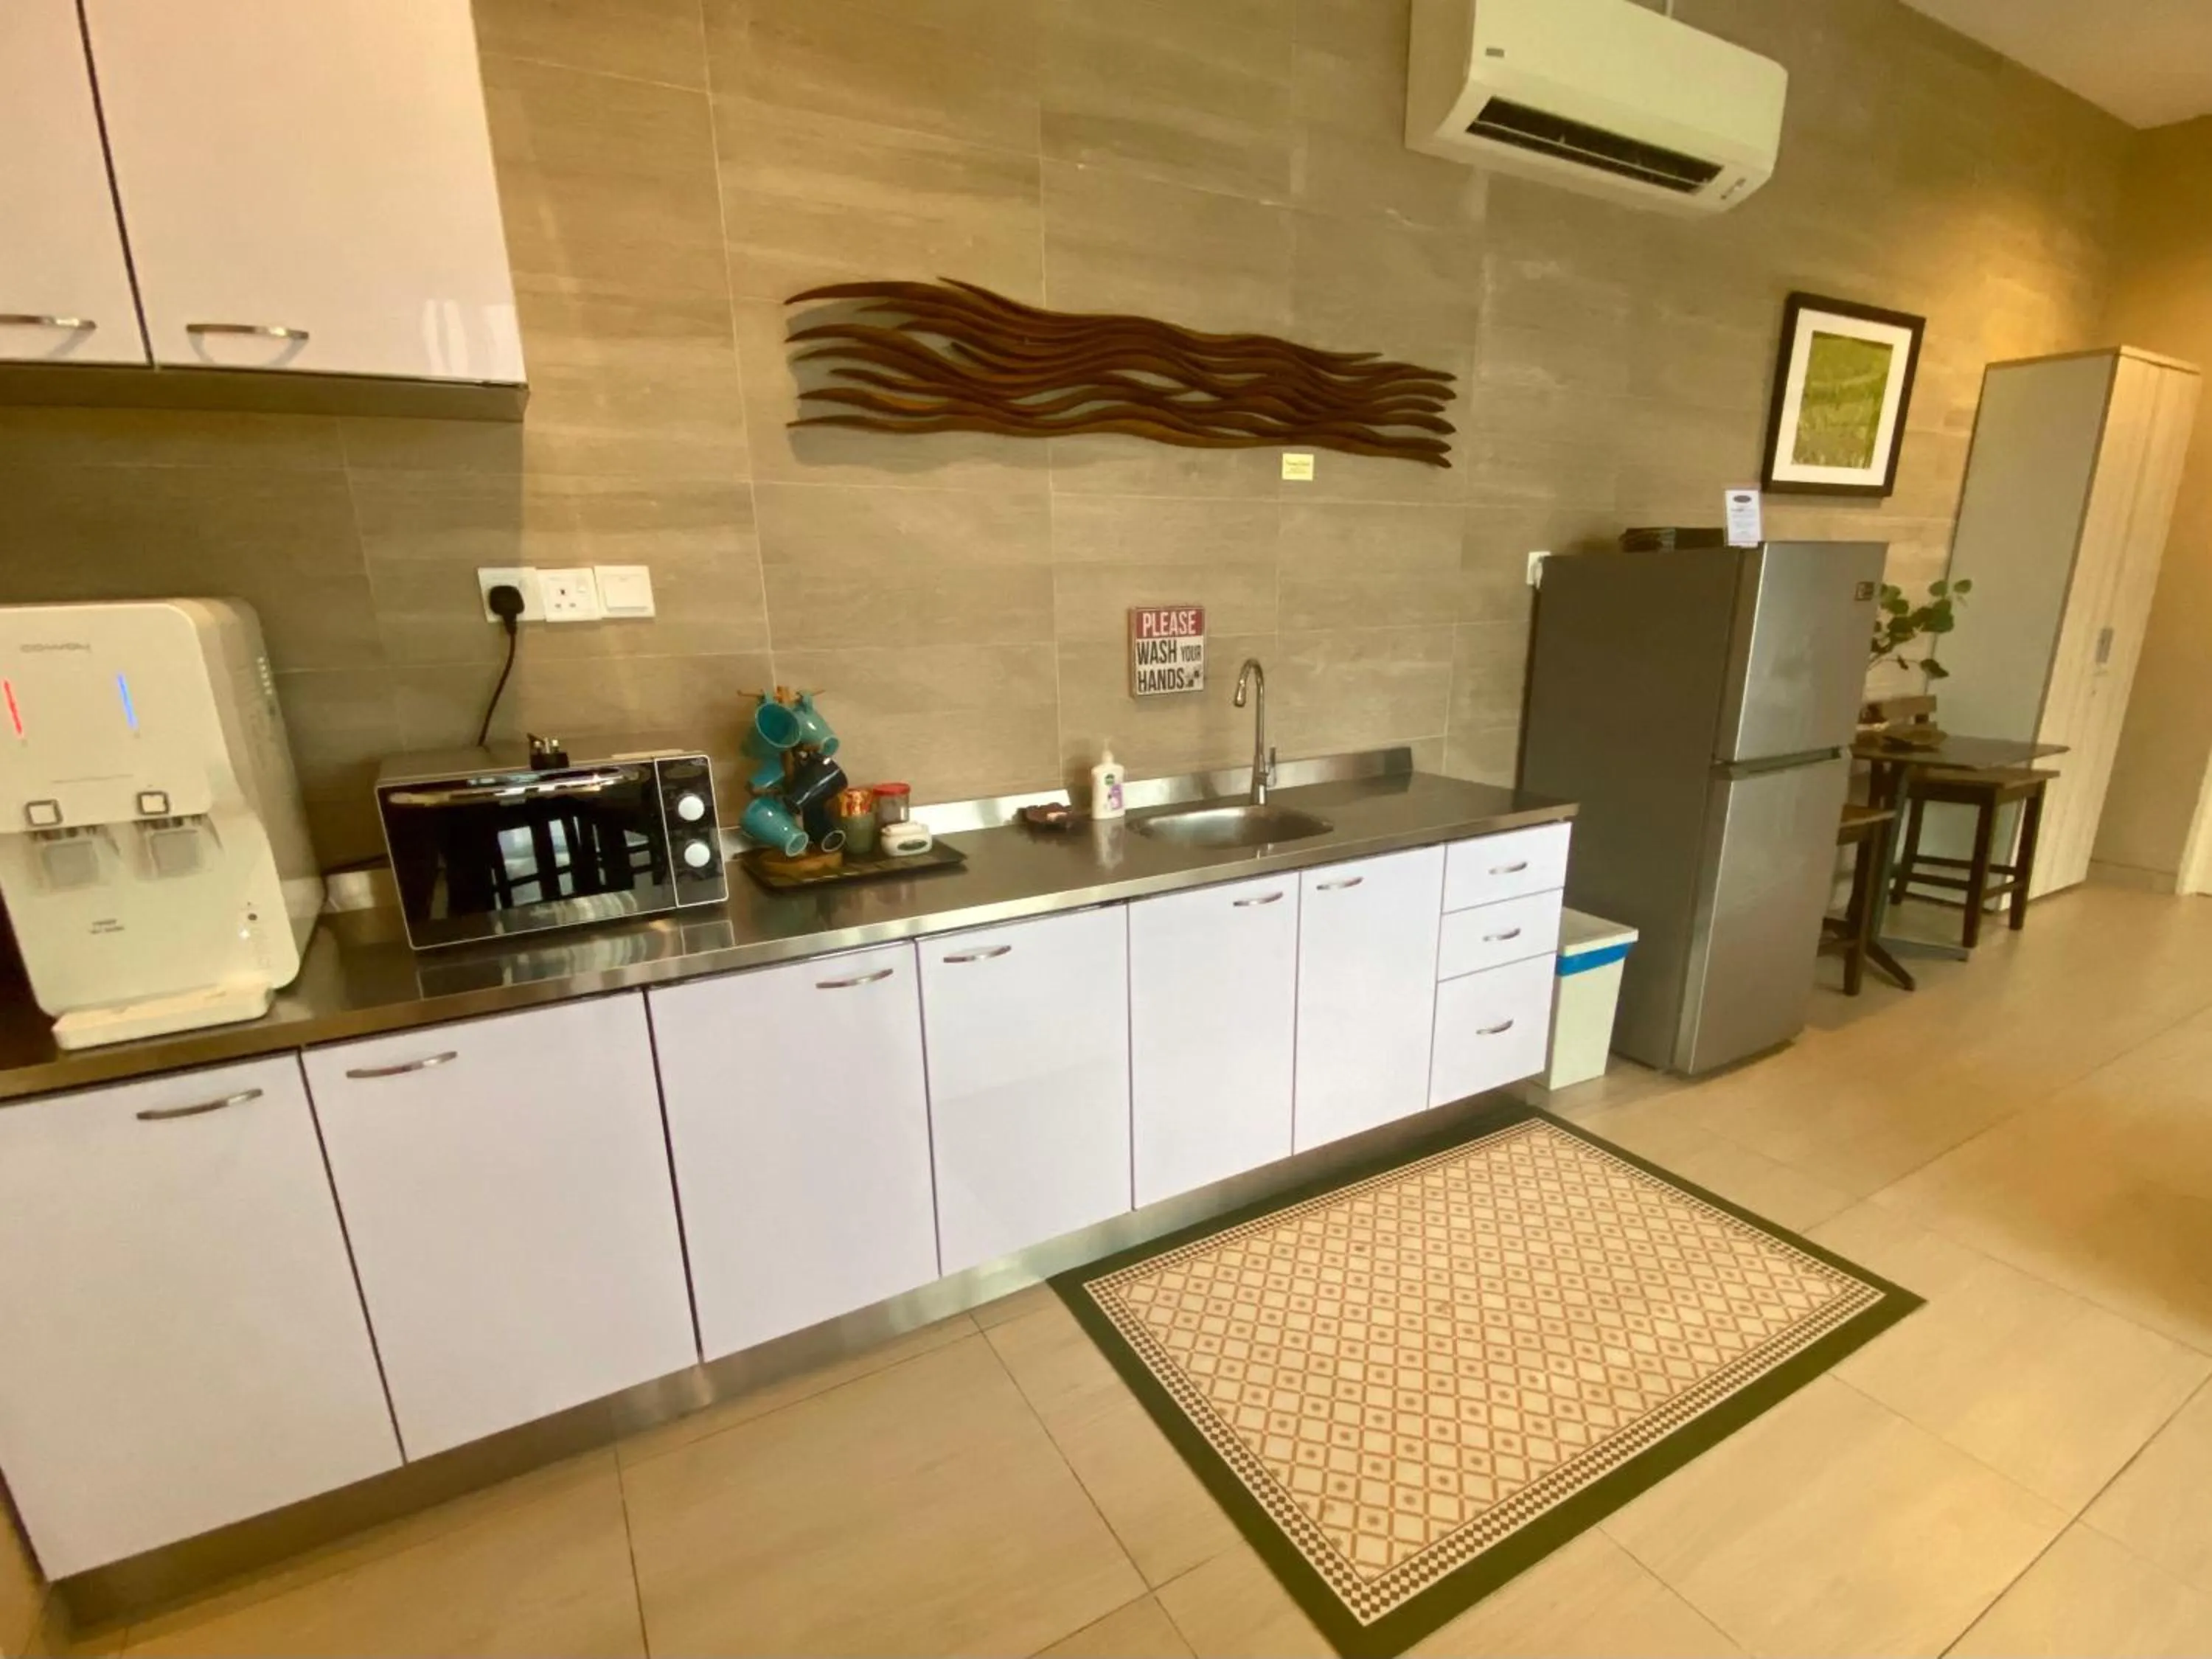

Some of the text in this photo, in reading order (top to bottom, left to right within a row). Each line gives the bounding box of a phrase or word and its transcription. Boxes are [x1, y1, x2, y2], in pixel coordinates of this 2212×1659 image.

[1142, 611, 1196, 637] PLEASE
[1137, 640, 1201, 665] WASH YOUR
[1138, 668, 1184, 692] HANDS
